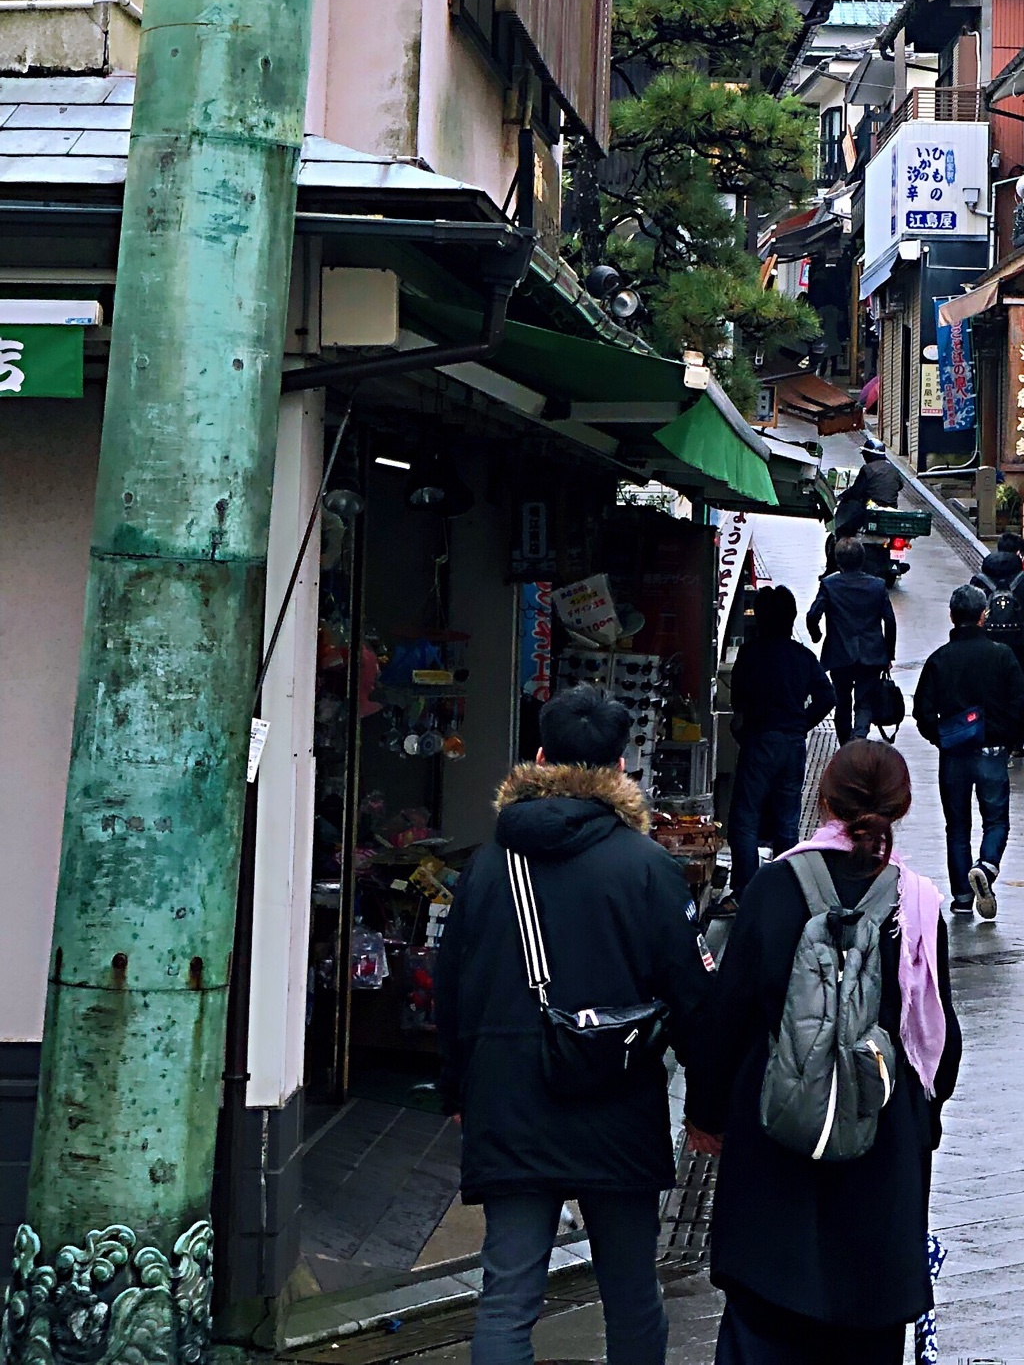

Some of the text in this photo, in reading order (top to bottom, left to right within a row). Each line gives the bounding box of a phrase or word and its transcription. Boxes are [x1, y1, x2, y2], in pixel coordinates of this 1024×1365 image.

[930, 147, 945, 201] ひもの
[909, 212, 953, 229] 江島屋
